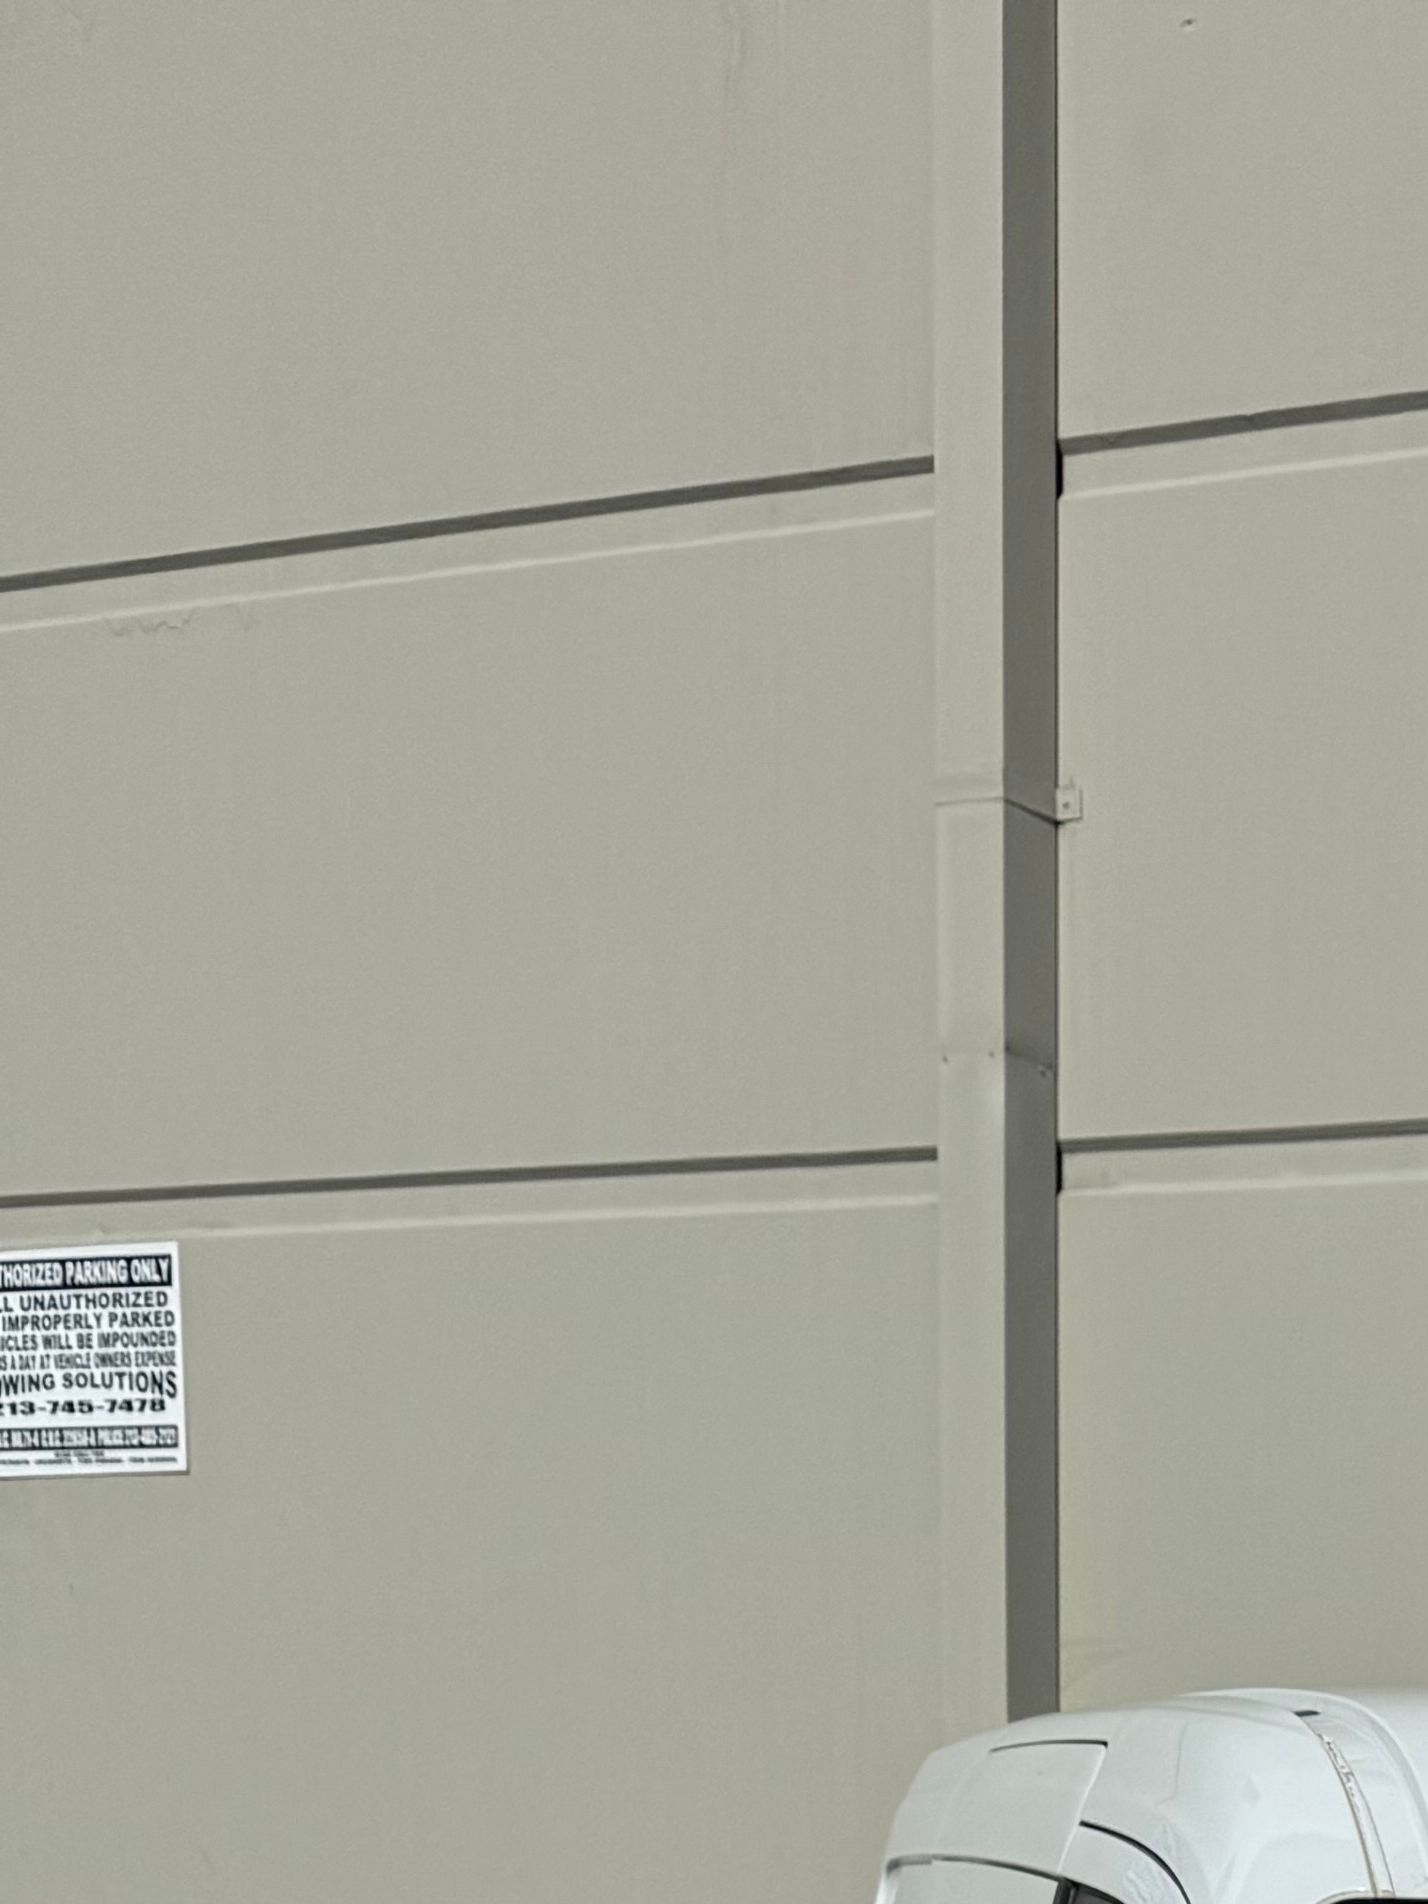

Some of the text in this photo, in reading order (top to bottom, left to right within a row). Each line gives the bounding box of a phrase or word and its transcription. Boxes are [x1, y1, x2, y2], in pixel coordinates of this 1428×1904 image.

[65, 1259, 129, 1286] PARKING
[130, 1258, 170, 1284] ONLY
[19, 1291, 168, 1312] UNAUTHORIZED
[2, 1310, 175, 1332] IMPROPERLY PARKED
[41, 1333, 73, 1350] WILL
[76, 1333, 94, 1349] BE
[97, 1330, 177, 1349] IMPOUNDED
[10, 1354, 16, 1370] A
[19, 1354, 36, 1370] DAY
[39, 1354, 50, 1370] AT
[54, 1352, 91, 1369] VEHICLE
[94, 1351, 132, 1369] OWNERS
[135, 1350, 177, 1367] EXPENSE
[0, 1370, 177, 1399] WING SOLUTIONS
